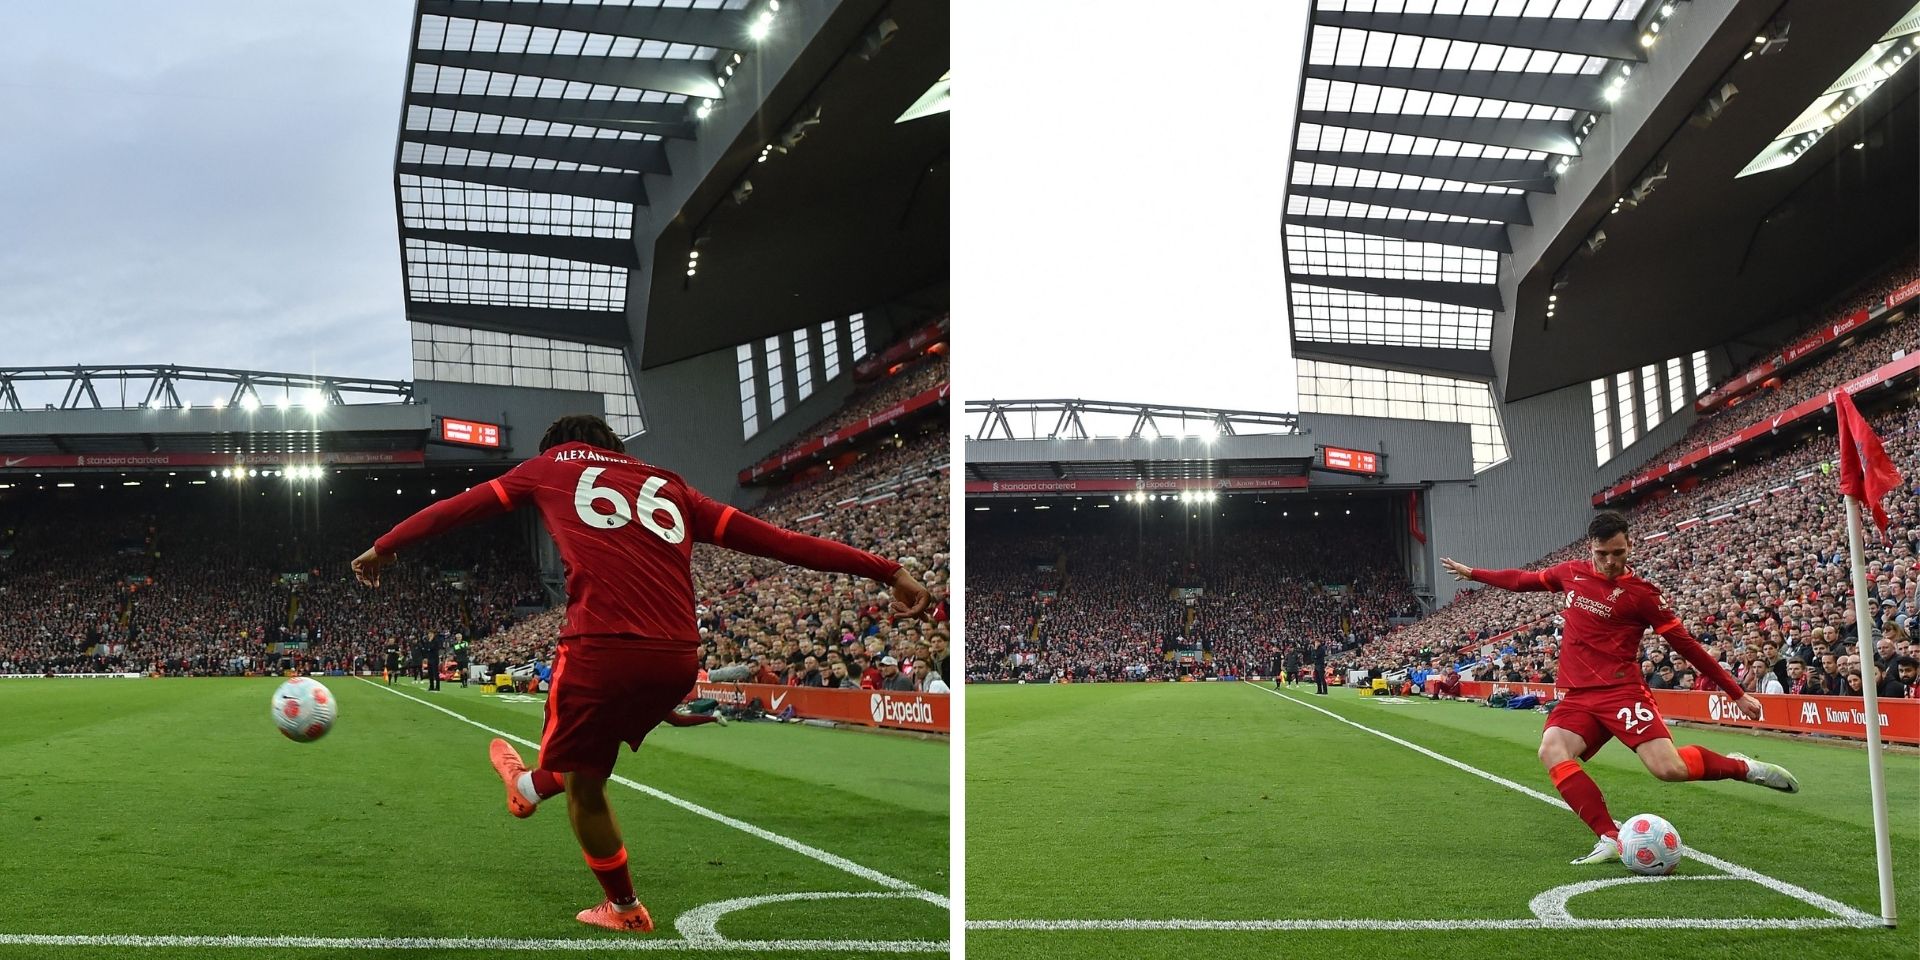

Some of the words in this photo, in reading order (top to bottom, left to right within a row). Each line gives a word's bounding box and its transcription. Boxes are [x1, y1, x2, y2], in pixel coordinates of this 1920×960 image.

[86, 456, 126, 464] standard
[127, 456, 169, 464] chartered
[245, 453, 279, 463] Expedia
[1001, 482, 1036, 490] standard
[1037, 482, 1076, 490] chartered
[1146, 480, 1177, 489] Expedia
[574, 466, 685, 544] 66
[1573, 601, 1611, 618] chartered
[1576, 595, 1613, 613] standard
[884, 695, 934, 724] Expedia
[1617, 702, 1655, 730] 26
[1721, 696, 1765, 723] Expa
[1800, 702, 1822, 725] AXA
[1825, 707, 1850, 723] Know
